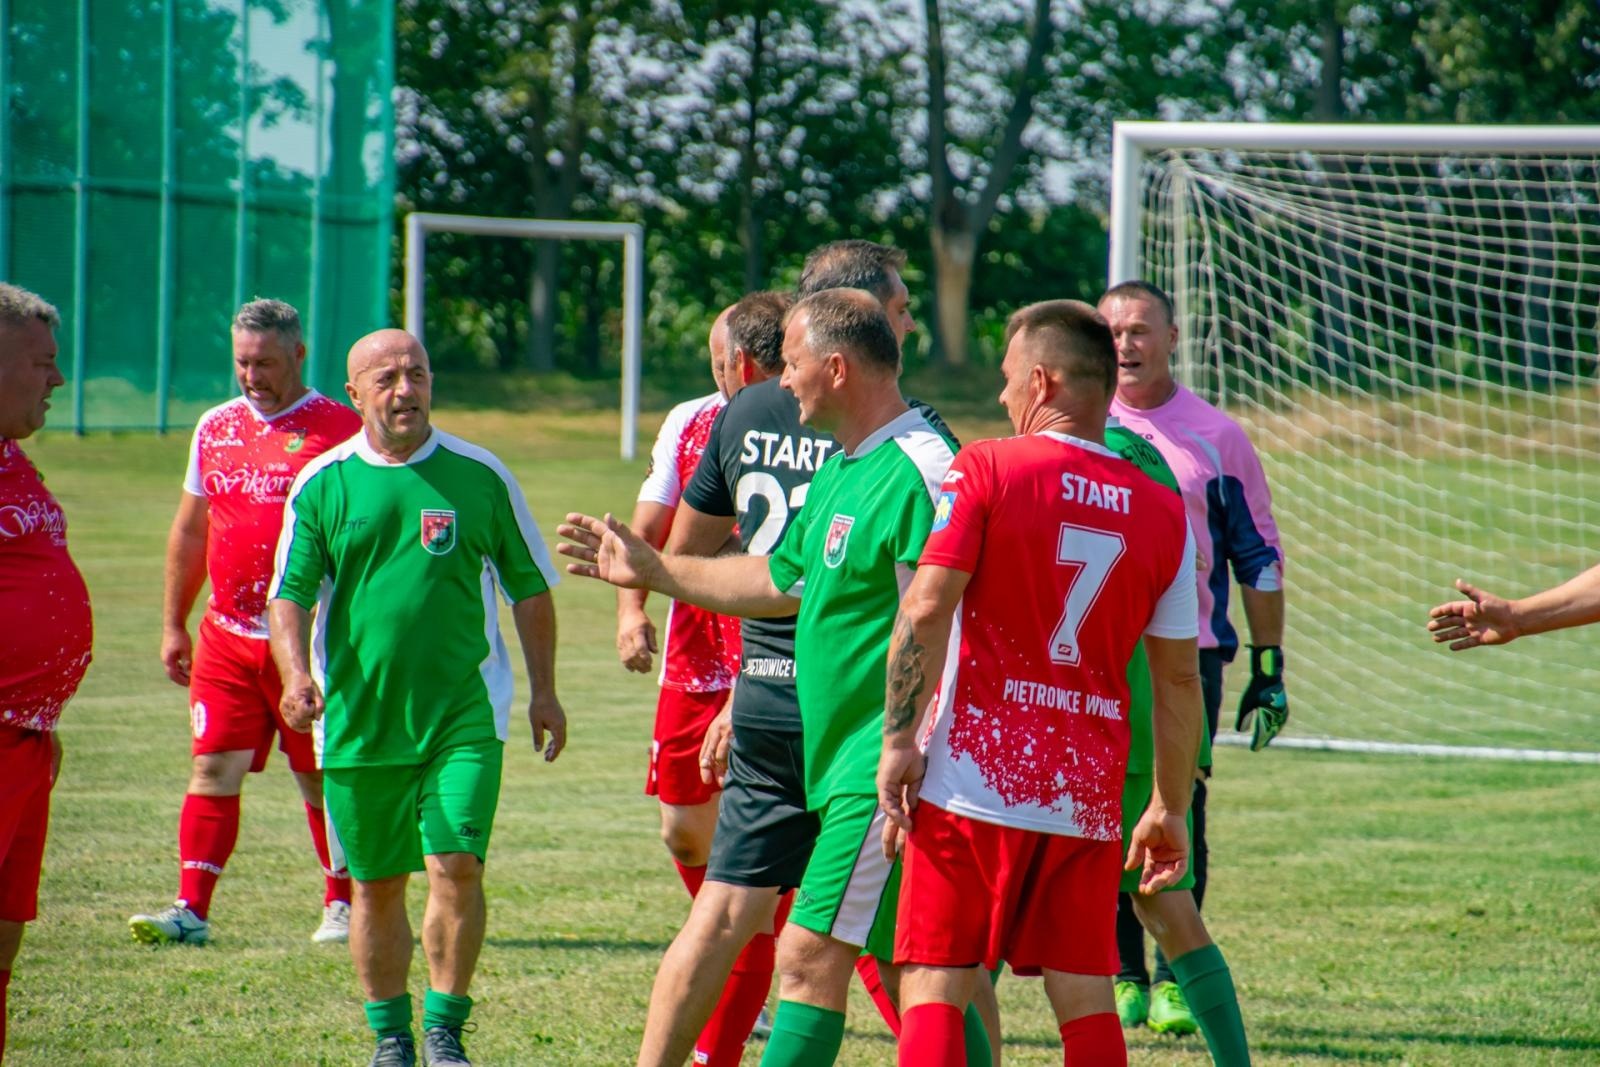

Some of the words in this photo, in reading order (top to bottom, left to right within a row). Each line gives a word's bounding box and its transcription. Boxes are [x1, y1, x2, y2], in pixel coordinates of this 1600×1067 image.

[739, 429, 833, 472] START
[1061, 471, 1133, 515] START
[1047, 521, 1127, 668] 7
